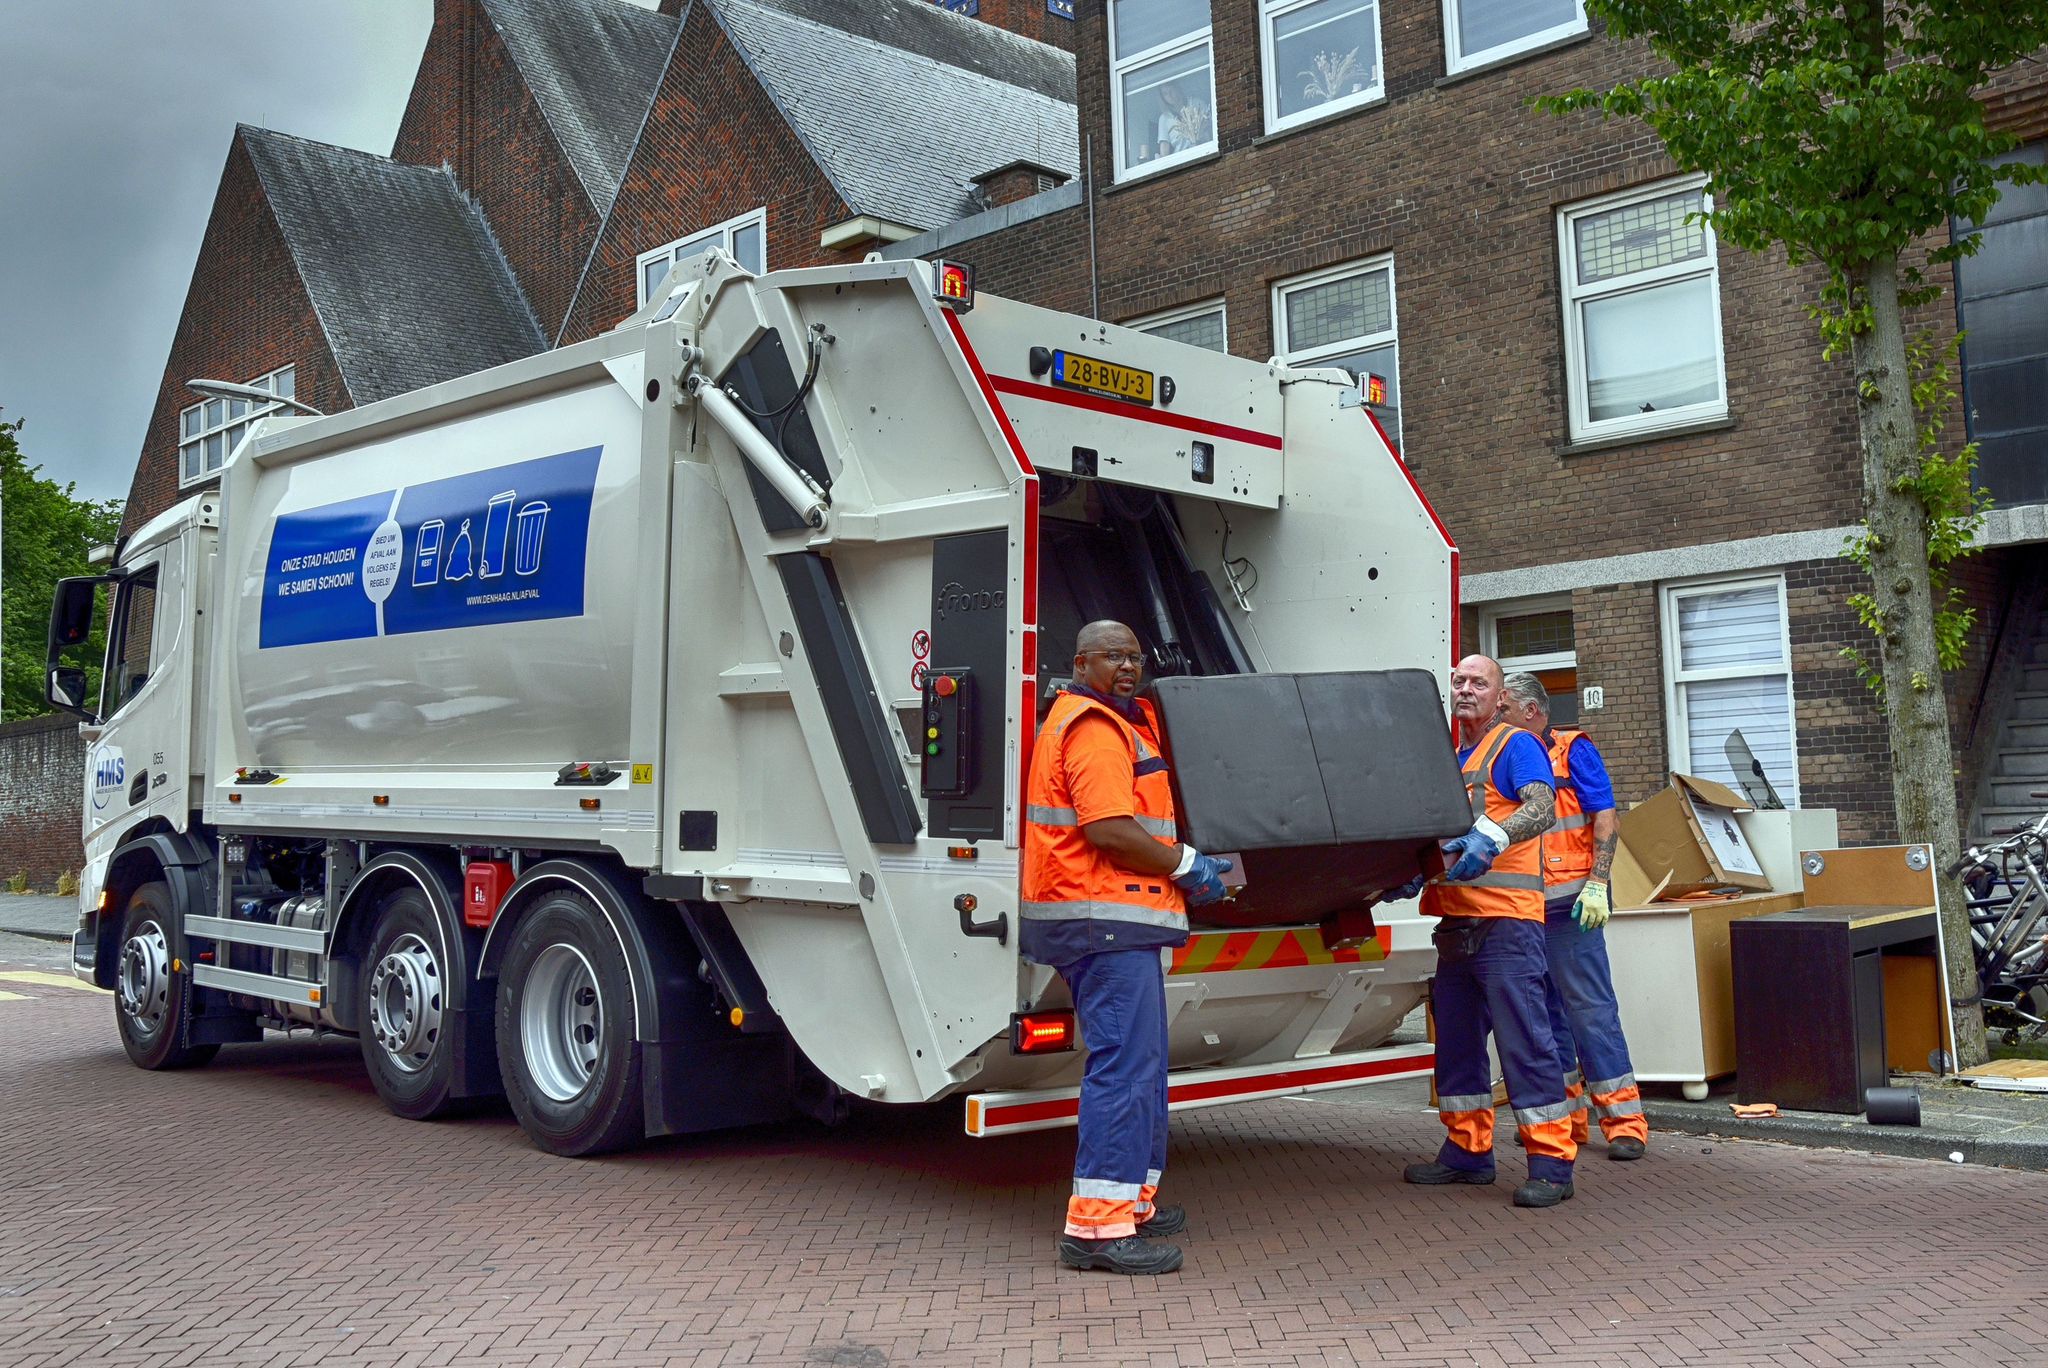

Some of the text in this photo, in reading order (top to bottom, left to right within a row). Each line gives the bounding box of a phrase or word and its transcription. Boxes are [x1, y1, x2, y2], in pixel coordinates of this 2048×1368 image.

[1071, 359, 1144, 395] 28-BVJ-3
[375, 534, 396, 545] BIED UW
[281, 547, 357, 573] ONZE STAD HOUDEN
[370, 548, 397, 560] AFVAL AAN
[366, 562, 397, 574] VOLGENS DE
[278, 571, 355, 596] WE SAMEN SCHOON!
[369, 577, 391, 588] REGELS!
[466, 589, 540, 605] WWW.DENHAAG.NL/AFVAL
[1587, 690, 1600, 706] 10
[153, 752, 163, 765] 055
[96, 757, 124, 788] HMS
